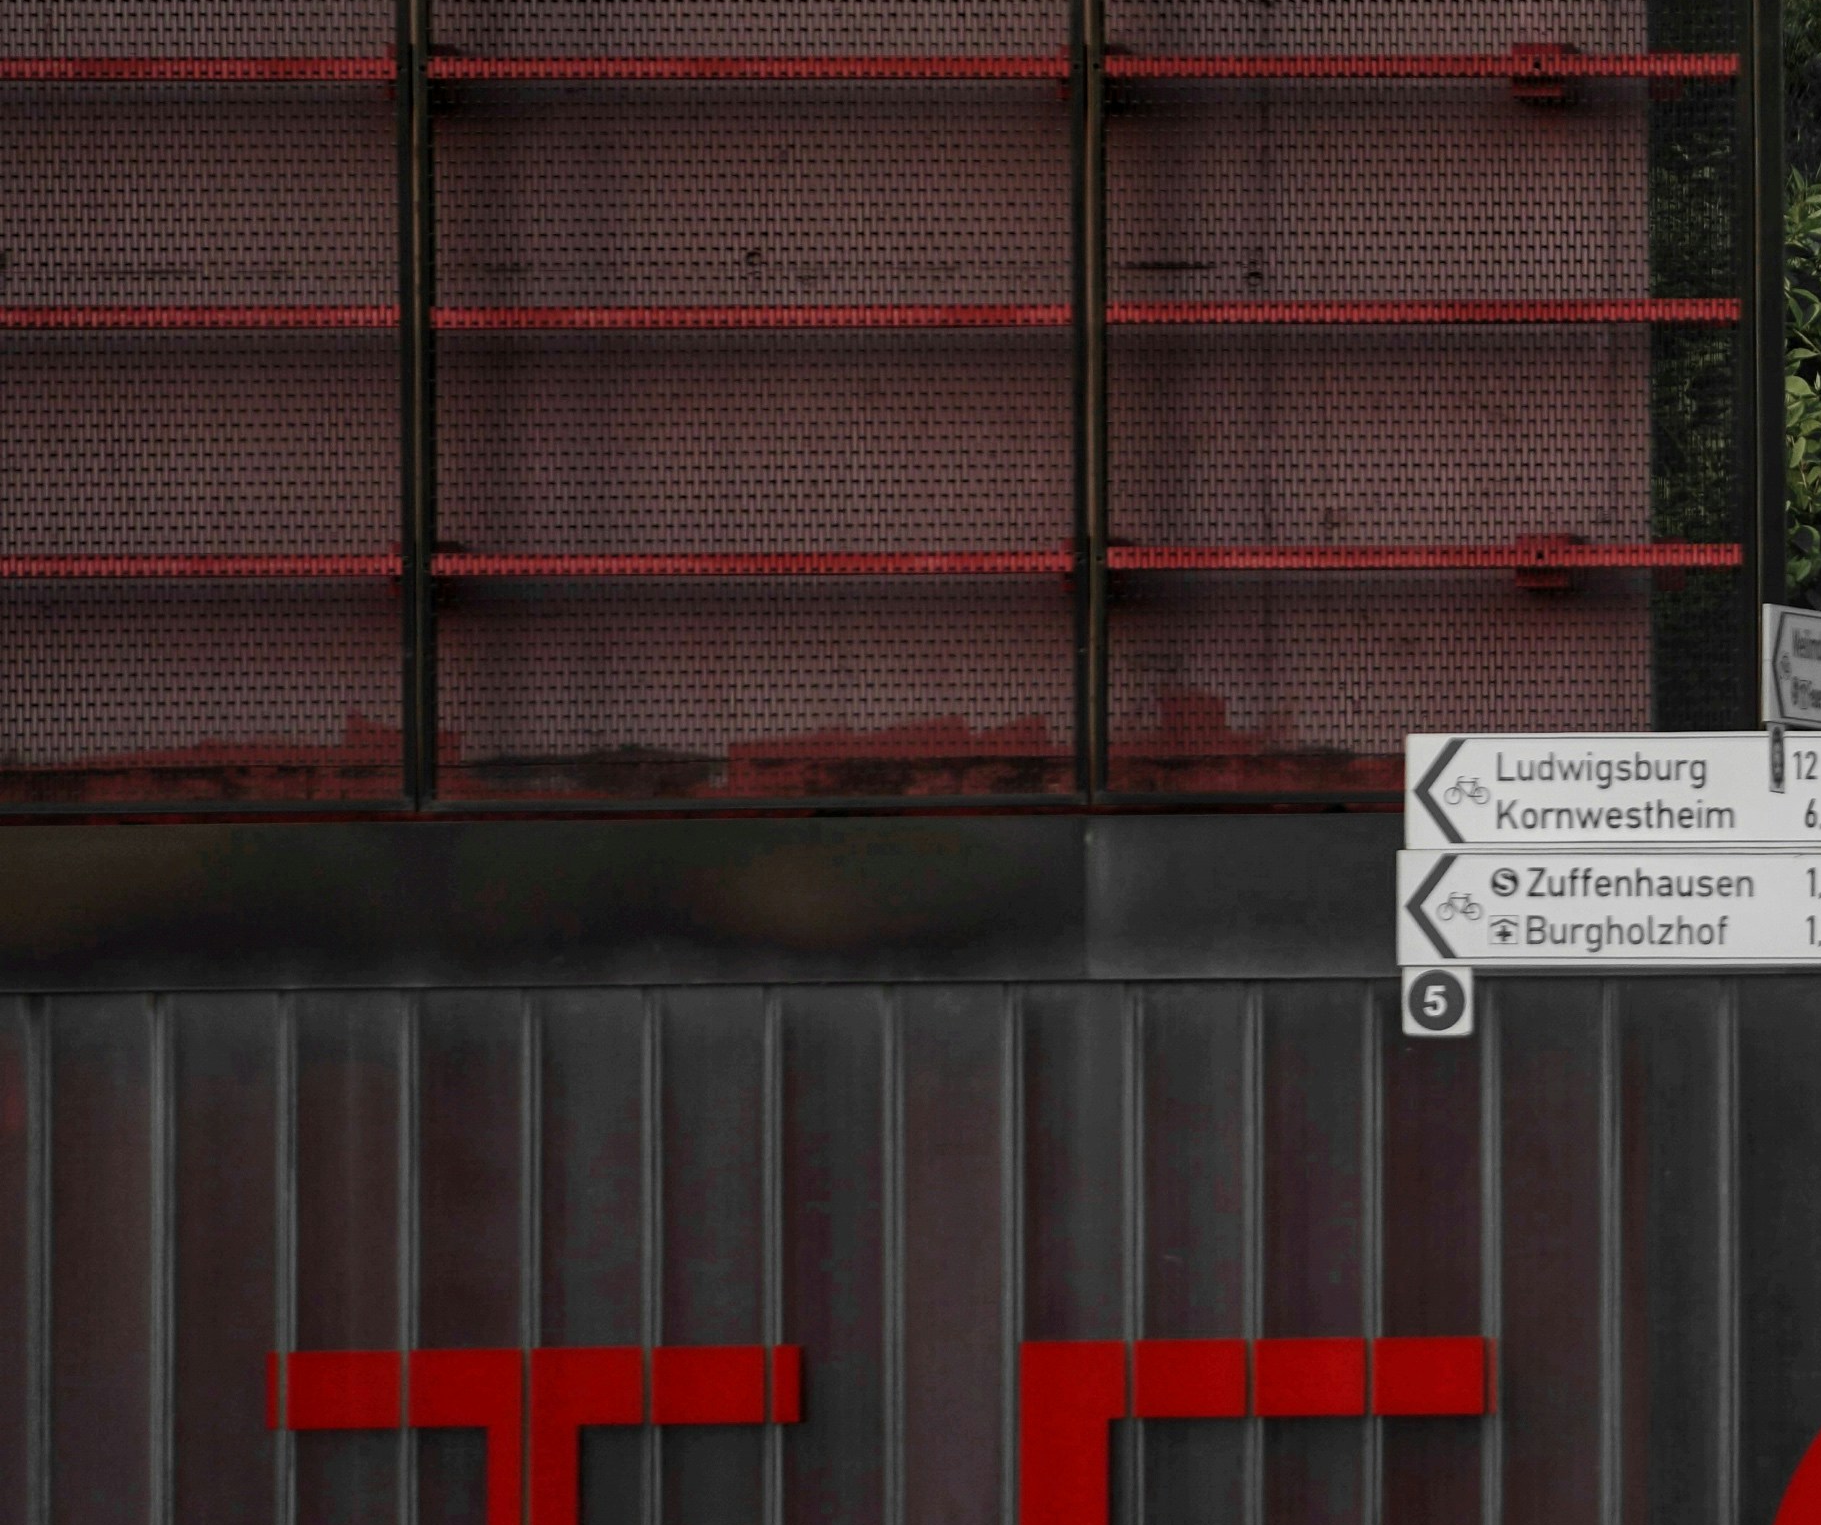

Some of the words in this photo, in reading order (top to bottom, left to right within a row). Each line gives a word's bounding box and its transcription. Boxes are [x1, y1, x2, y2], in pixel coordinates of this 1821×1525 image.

[1495, 750, 1708, 791] Ludwigsburg
[1793, 750, 1819, 781] 12
[1495, 798, 1736, 830] Kornwestheim
[1526, 866, 1755, 898] Zuffenhausen
[1525, 914, 1729, 953] Burgholzhof
[1422, 984, 1448, 1017] 5
